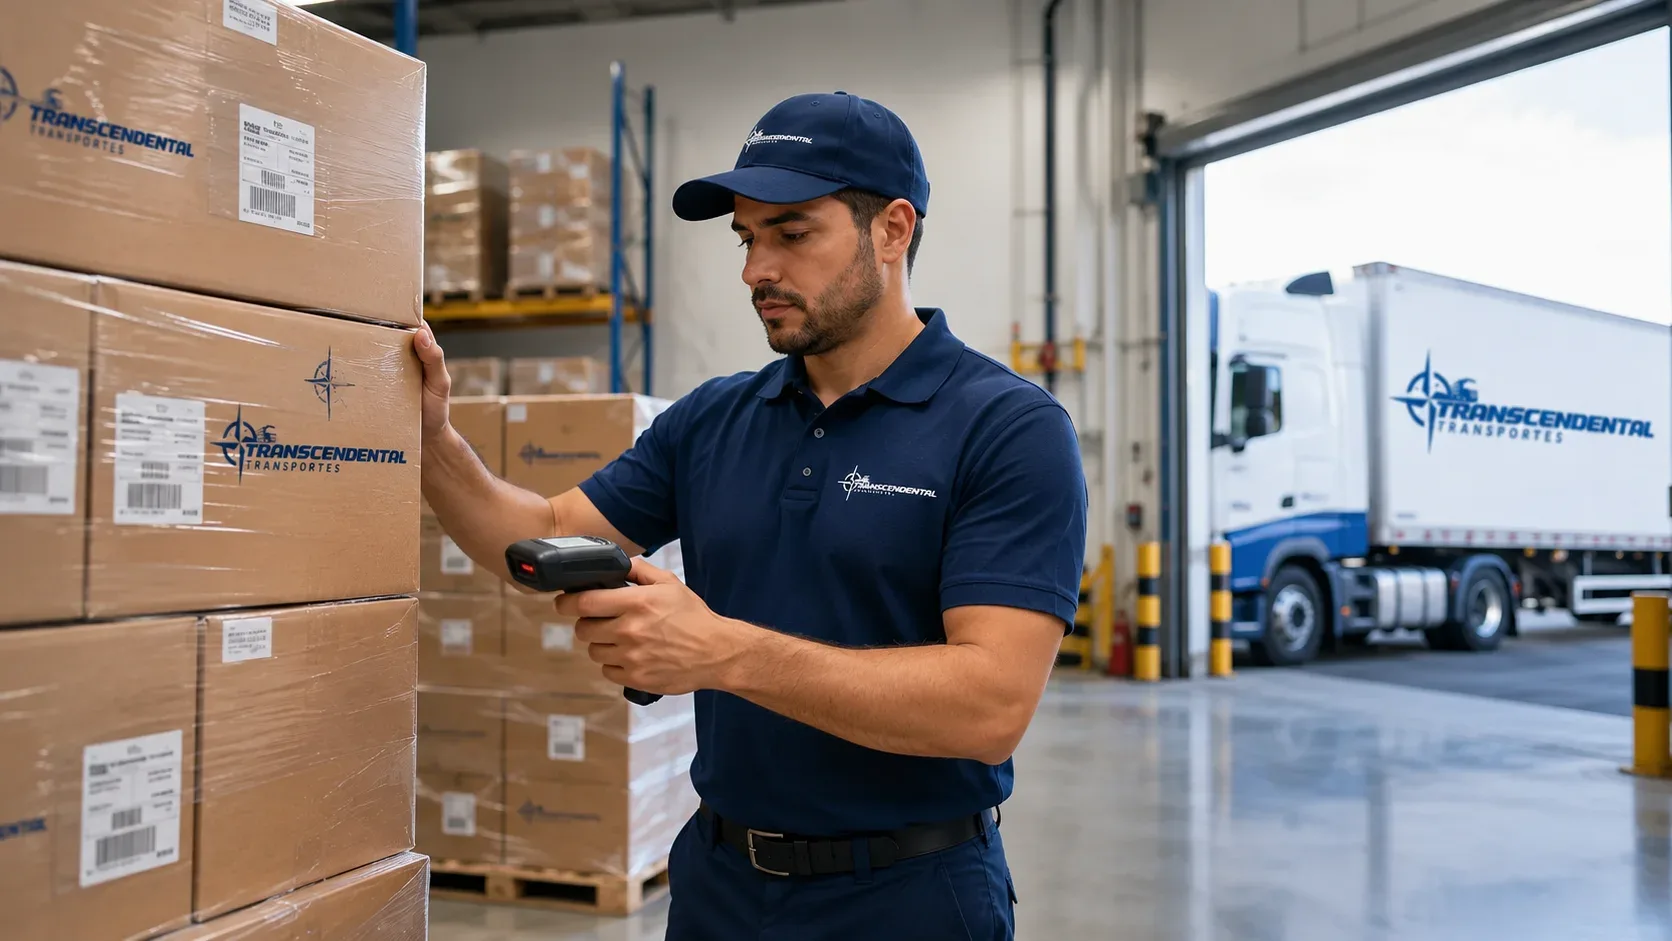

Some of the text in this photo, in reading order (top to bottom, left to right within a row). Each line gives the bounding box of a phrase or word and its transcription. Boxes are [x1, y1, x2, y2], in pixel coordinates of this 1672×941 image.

[29, 104, 195, 158] TRANSCENDENTAL
[29, 123, 125, 155] TRANSPORTES
[1437, 401, 1655, 438] TRANSCENDENTAL
[1437, 420, 1563, 443] TRANSPORTES
[245, 443, 408, 464] TRANSCENDENTAL
[245, 460, 341, 473] TRANSPORTES
